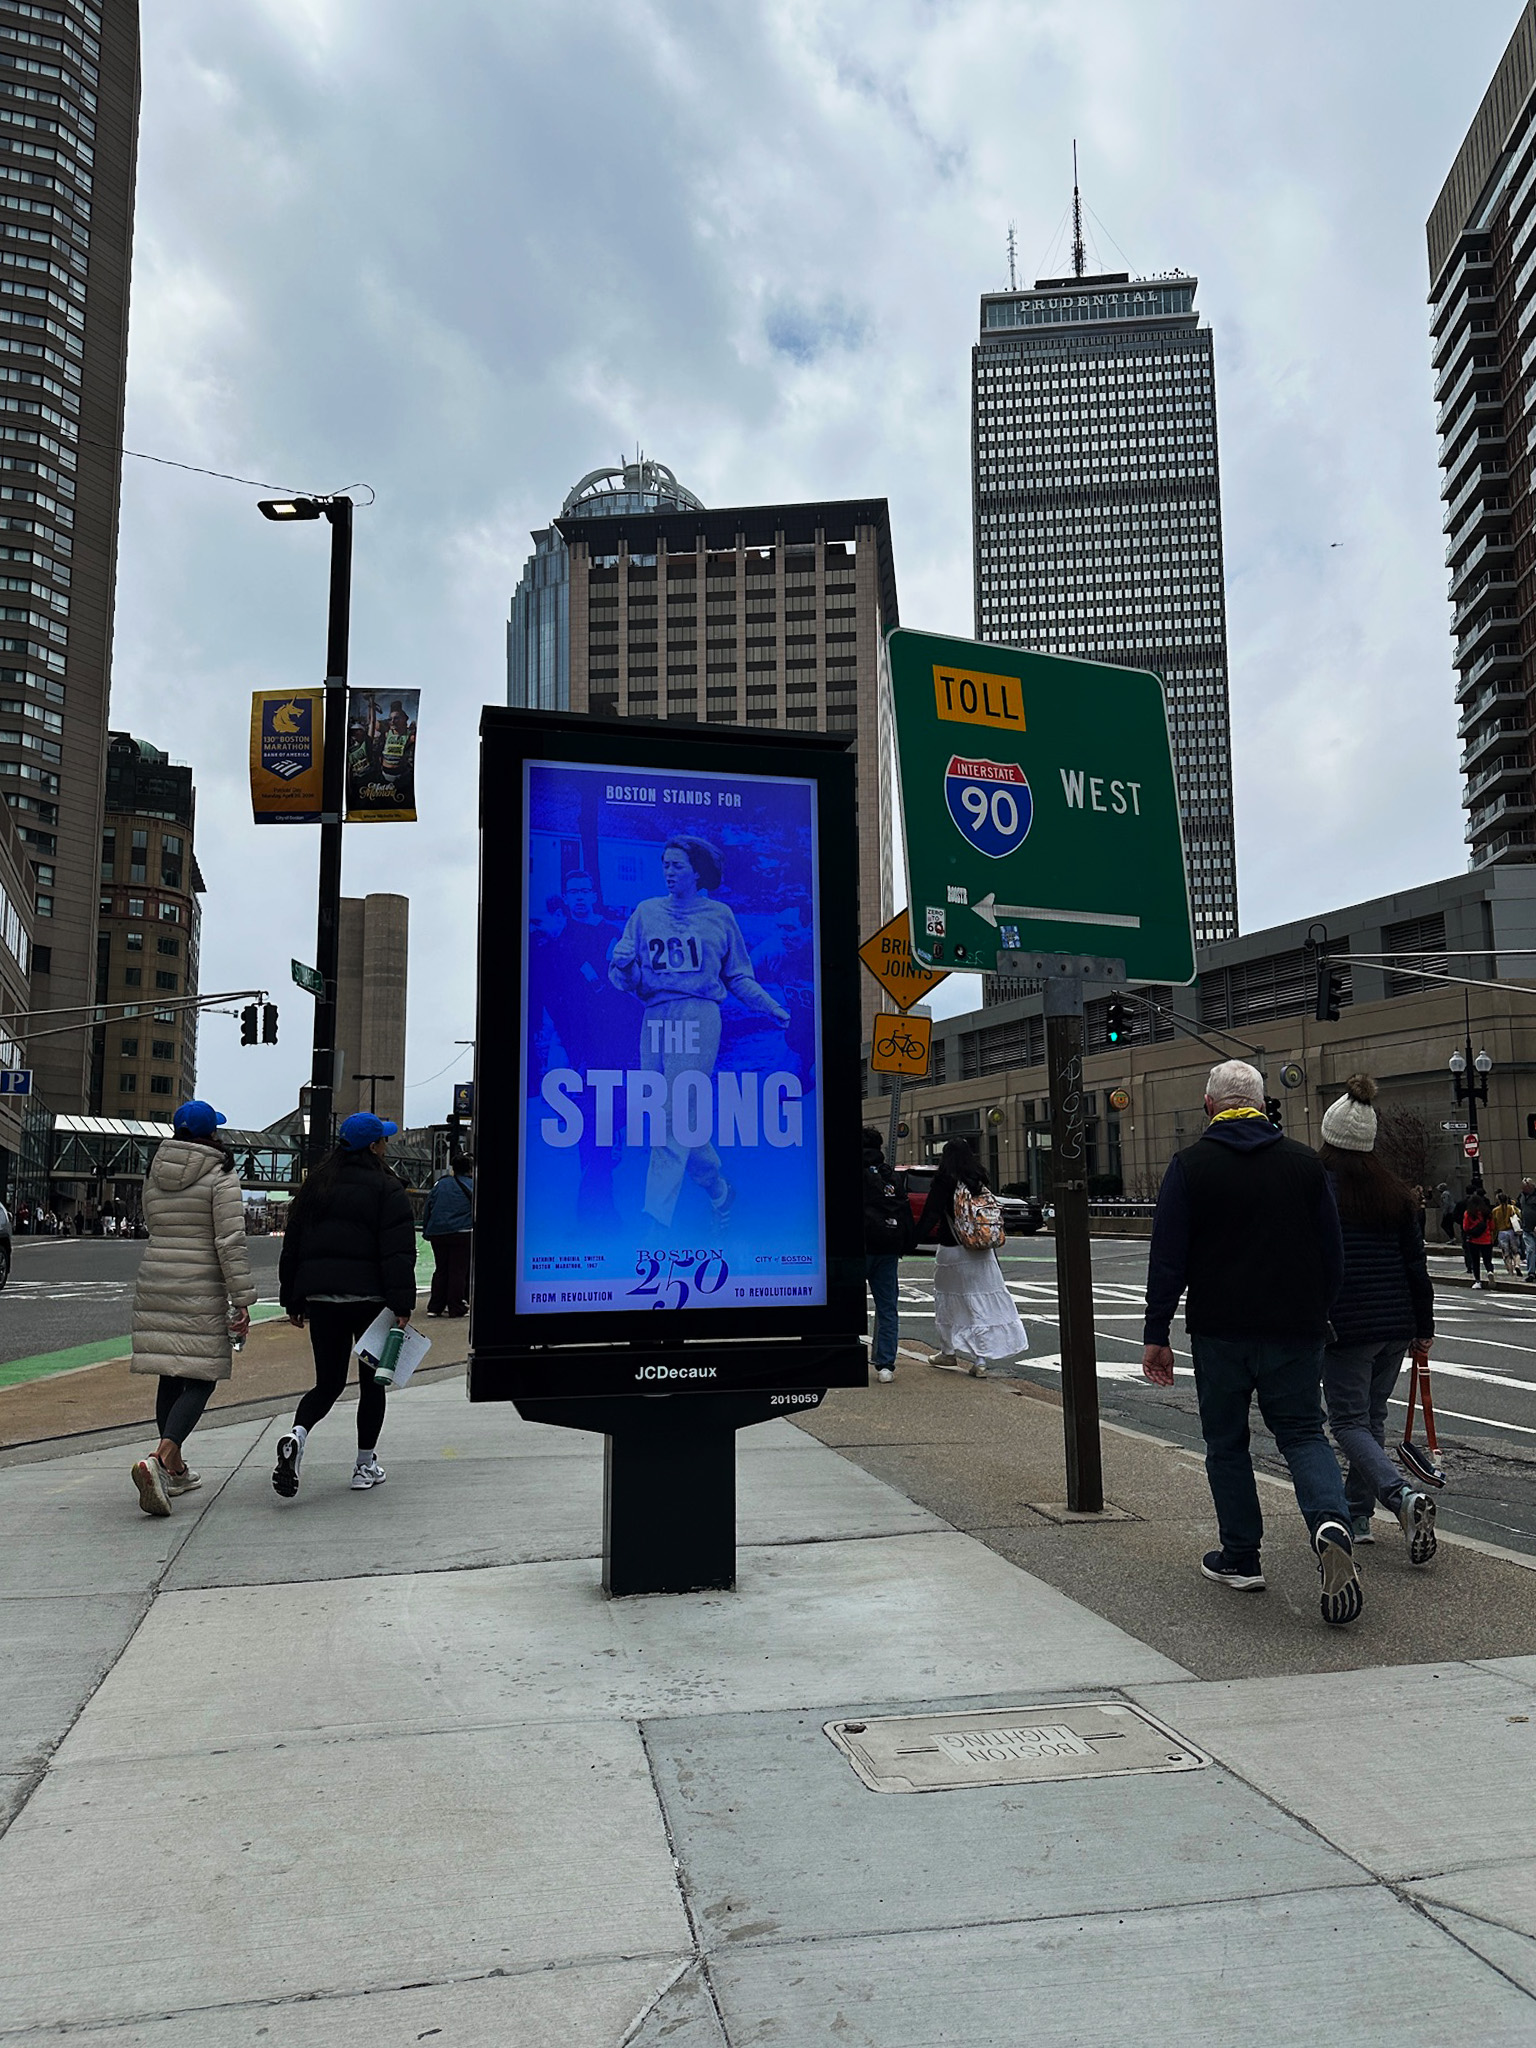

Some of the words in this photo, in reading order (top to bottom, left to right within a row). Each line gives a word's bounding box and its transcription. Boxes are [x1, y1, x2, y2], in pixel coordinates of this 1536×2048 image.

[1020, 290, 1158, 312] PRUDENTIAL
[940, 676, 1019, 720] TOLL
[280, 735, 310, 743] BOSTON
[957, 763, 1015, 781] INTERSTATE
[606, 785, 656, 802] BOSTON
[663, 789, 711, 806] STANDS
[718, 793, 741, 807] FOR
[961, 786, 1019, 835] 90
[1059, 768, 1141, 815] WEST
[649, 936, 699, 971] 261
[647, 1019, 701, 1054] THE
[6, 1072, 25, 1092] P
[541, 1069, 803, 1148] STRONG
[636, 1249, 722, 1262] BOSTON
[626, 1256, 729, 1310] 250
[735, 1288, 745, 1297] TO
[749, 1287, 813, 1297] REVOLUTIONARY
[531, 1293, 556, 1303] FROM
[561, 1291, 613, 1302] REVOLUTION
[635, 1366, 717, 1380] JCDecaux
[770, 1394, 818, 1405] 2019059
[943, 1728, 1067, 1748] LIGHTING
[966, 1743, 1079, 1761] BOSTON
